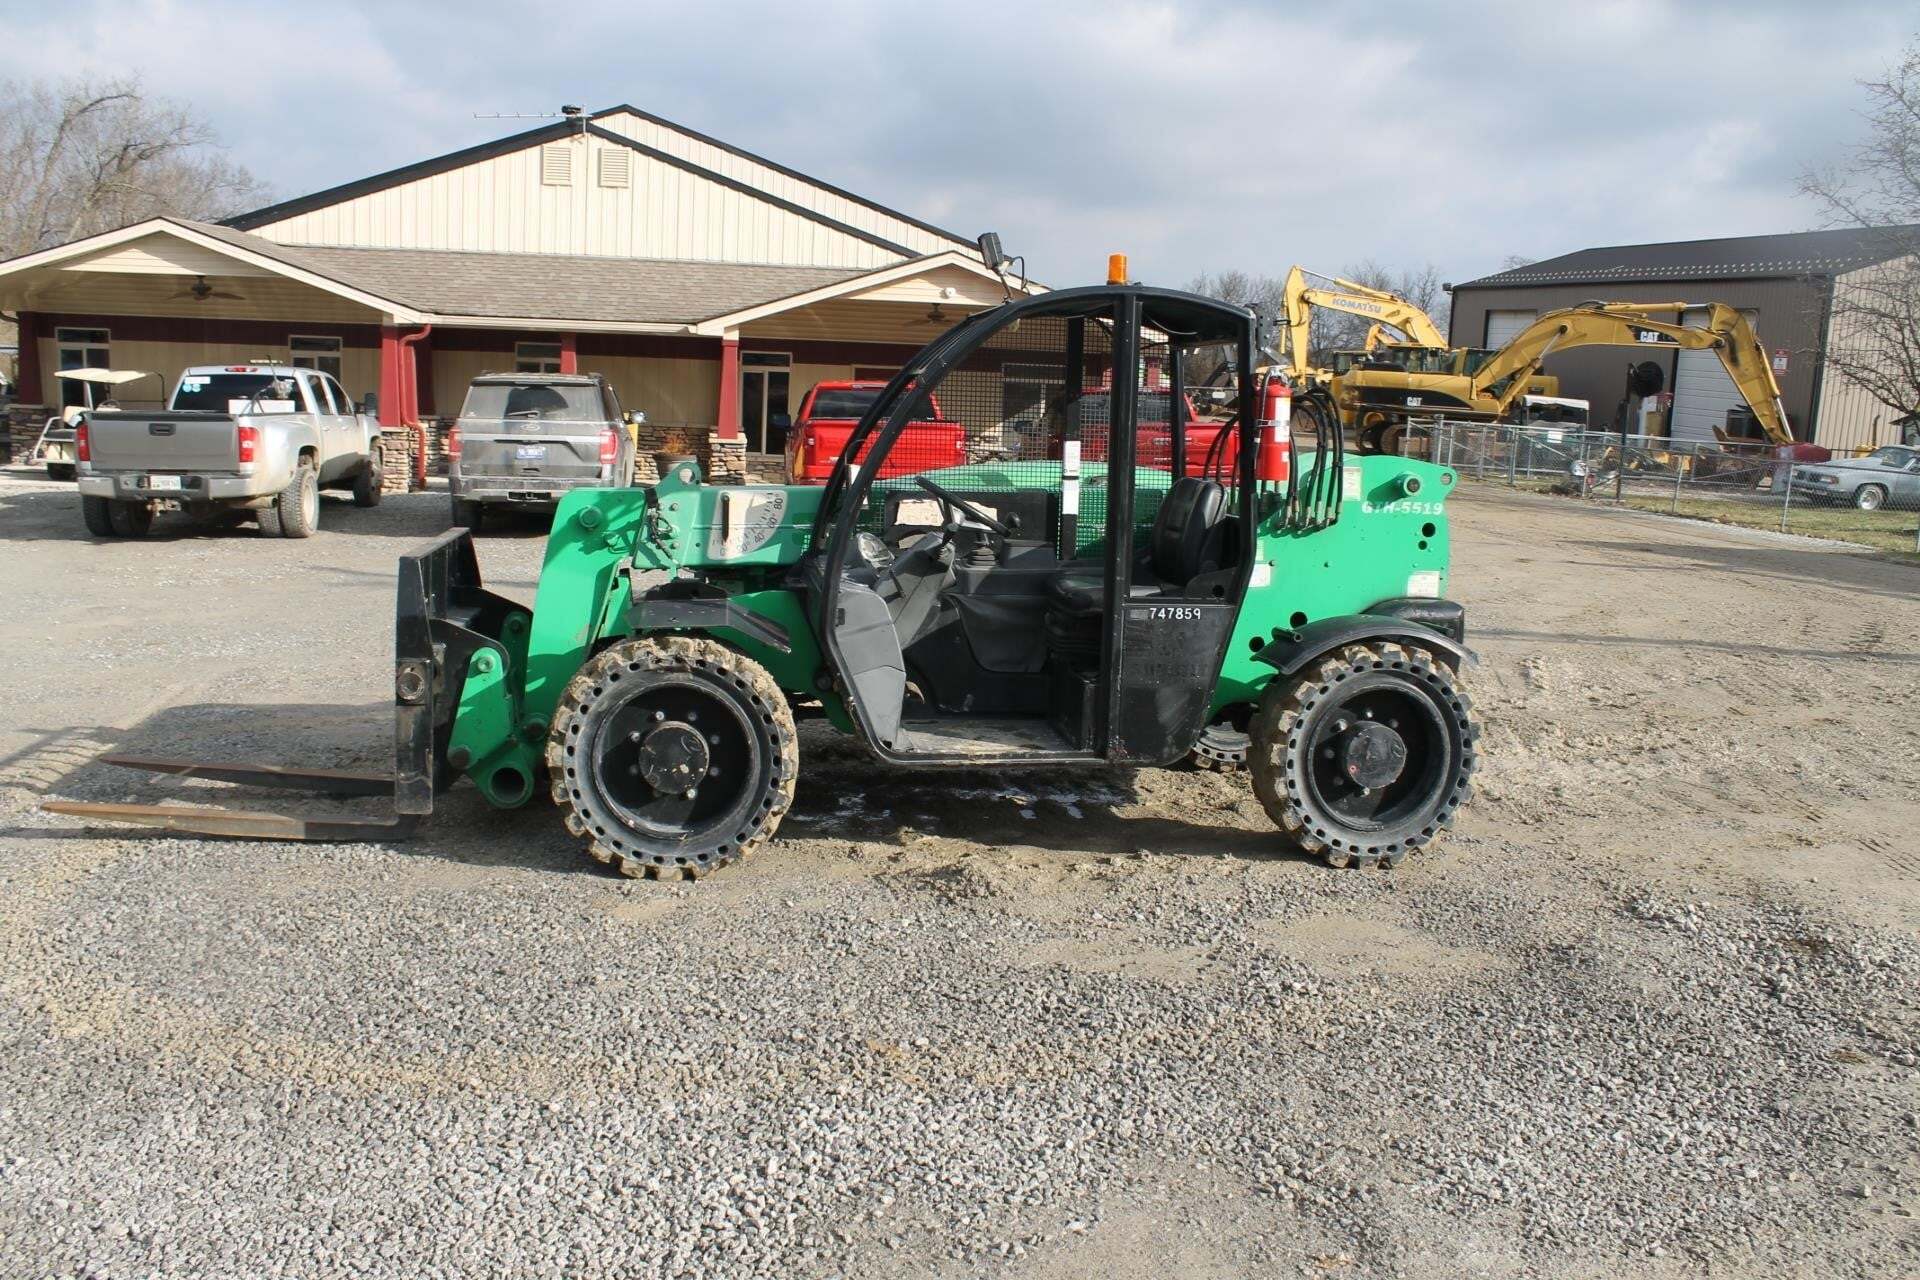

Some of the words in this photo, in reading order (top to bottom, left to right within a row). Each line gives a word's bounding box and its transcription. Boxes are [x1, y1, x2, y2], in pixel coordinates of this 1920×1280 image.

[1332, 299, 1382, 313] KOMATSU
[1640, 331, 1660, 342] CAT
[1407, 396, 1423, 406] CAT
[1149, 607, 1201, 620] 747859
